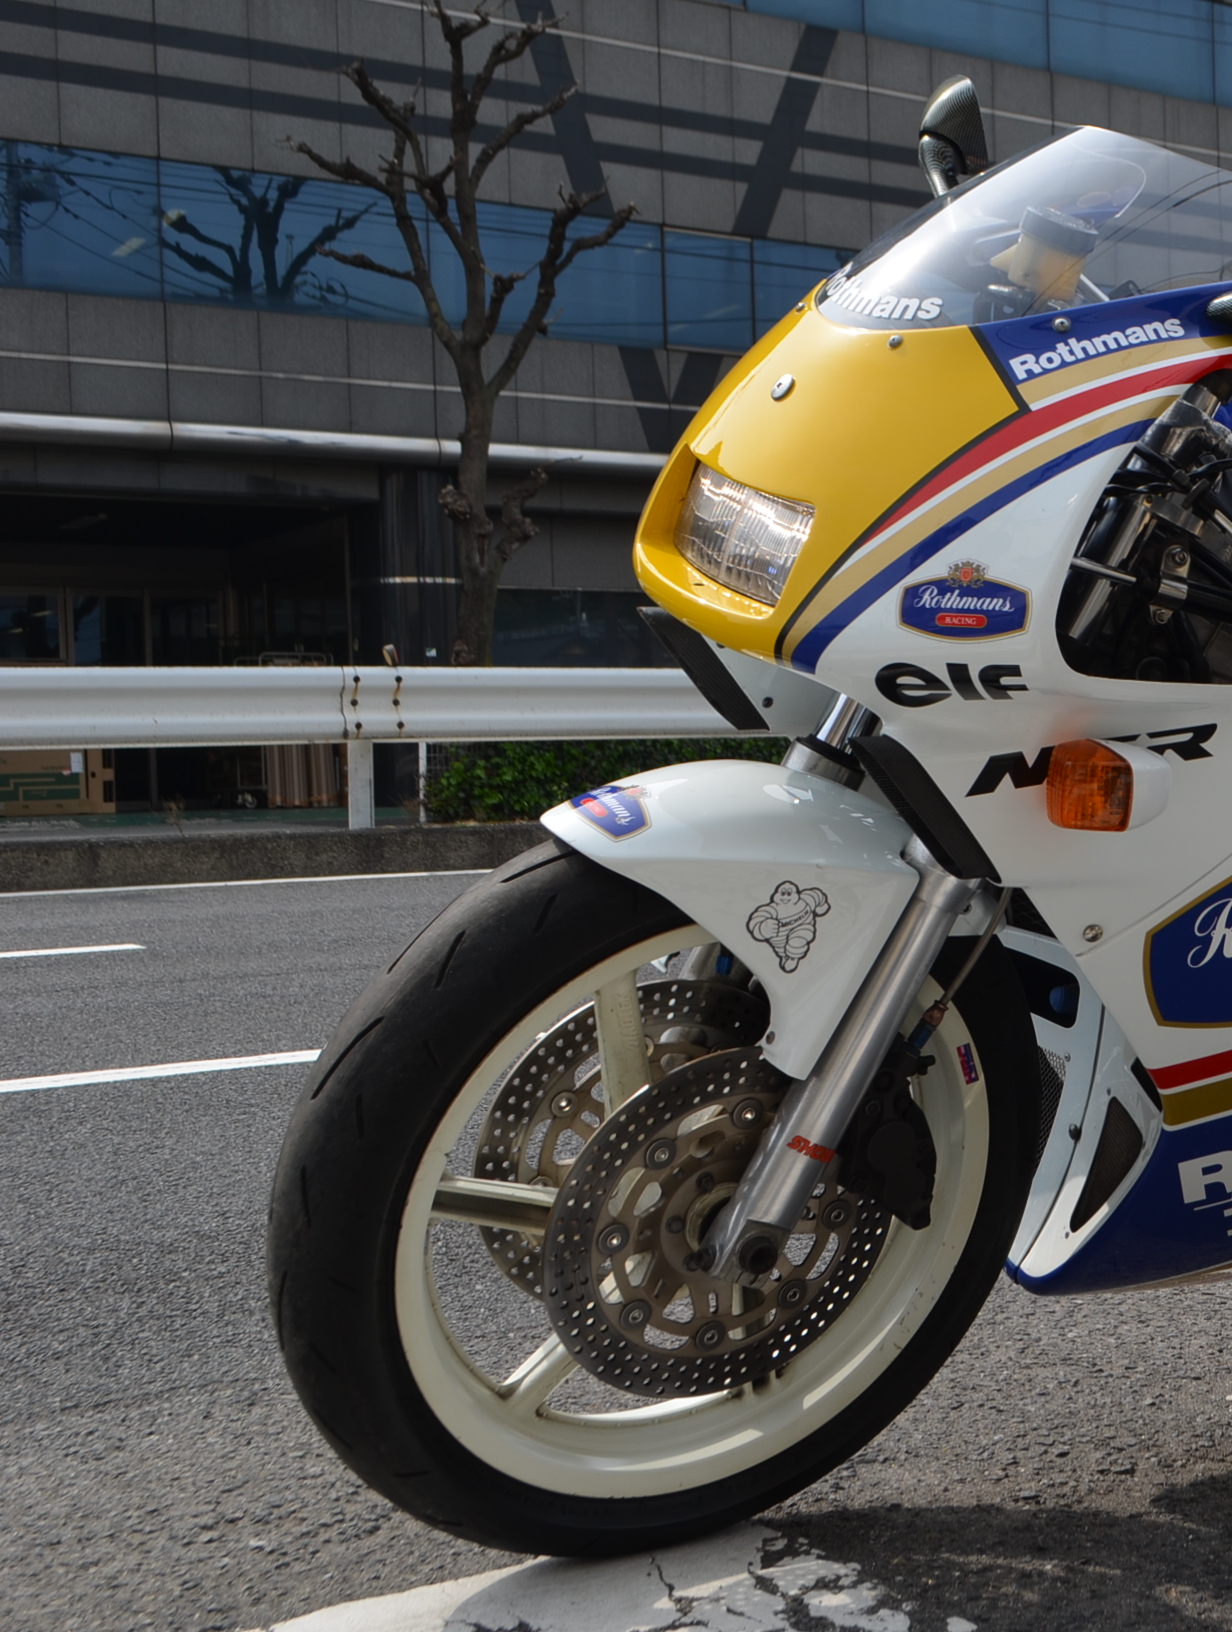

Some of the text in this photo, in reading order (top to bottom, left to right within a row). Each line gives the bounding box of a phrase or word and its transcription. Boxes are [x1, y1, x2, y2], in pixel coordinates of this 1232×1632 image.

[1008, 318, 1185, 382] Rothmans
[913, 585, 1015, 613] Rothmans
[944, 615, 978, 626] RACING
[875, 662, 1030, 708] elf
[965, 723, 1218, 798] NR
